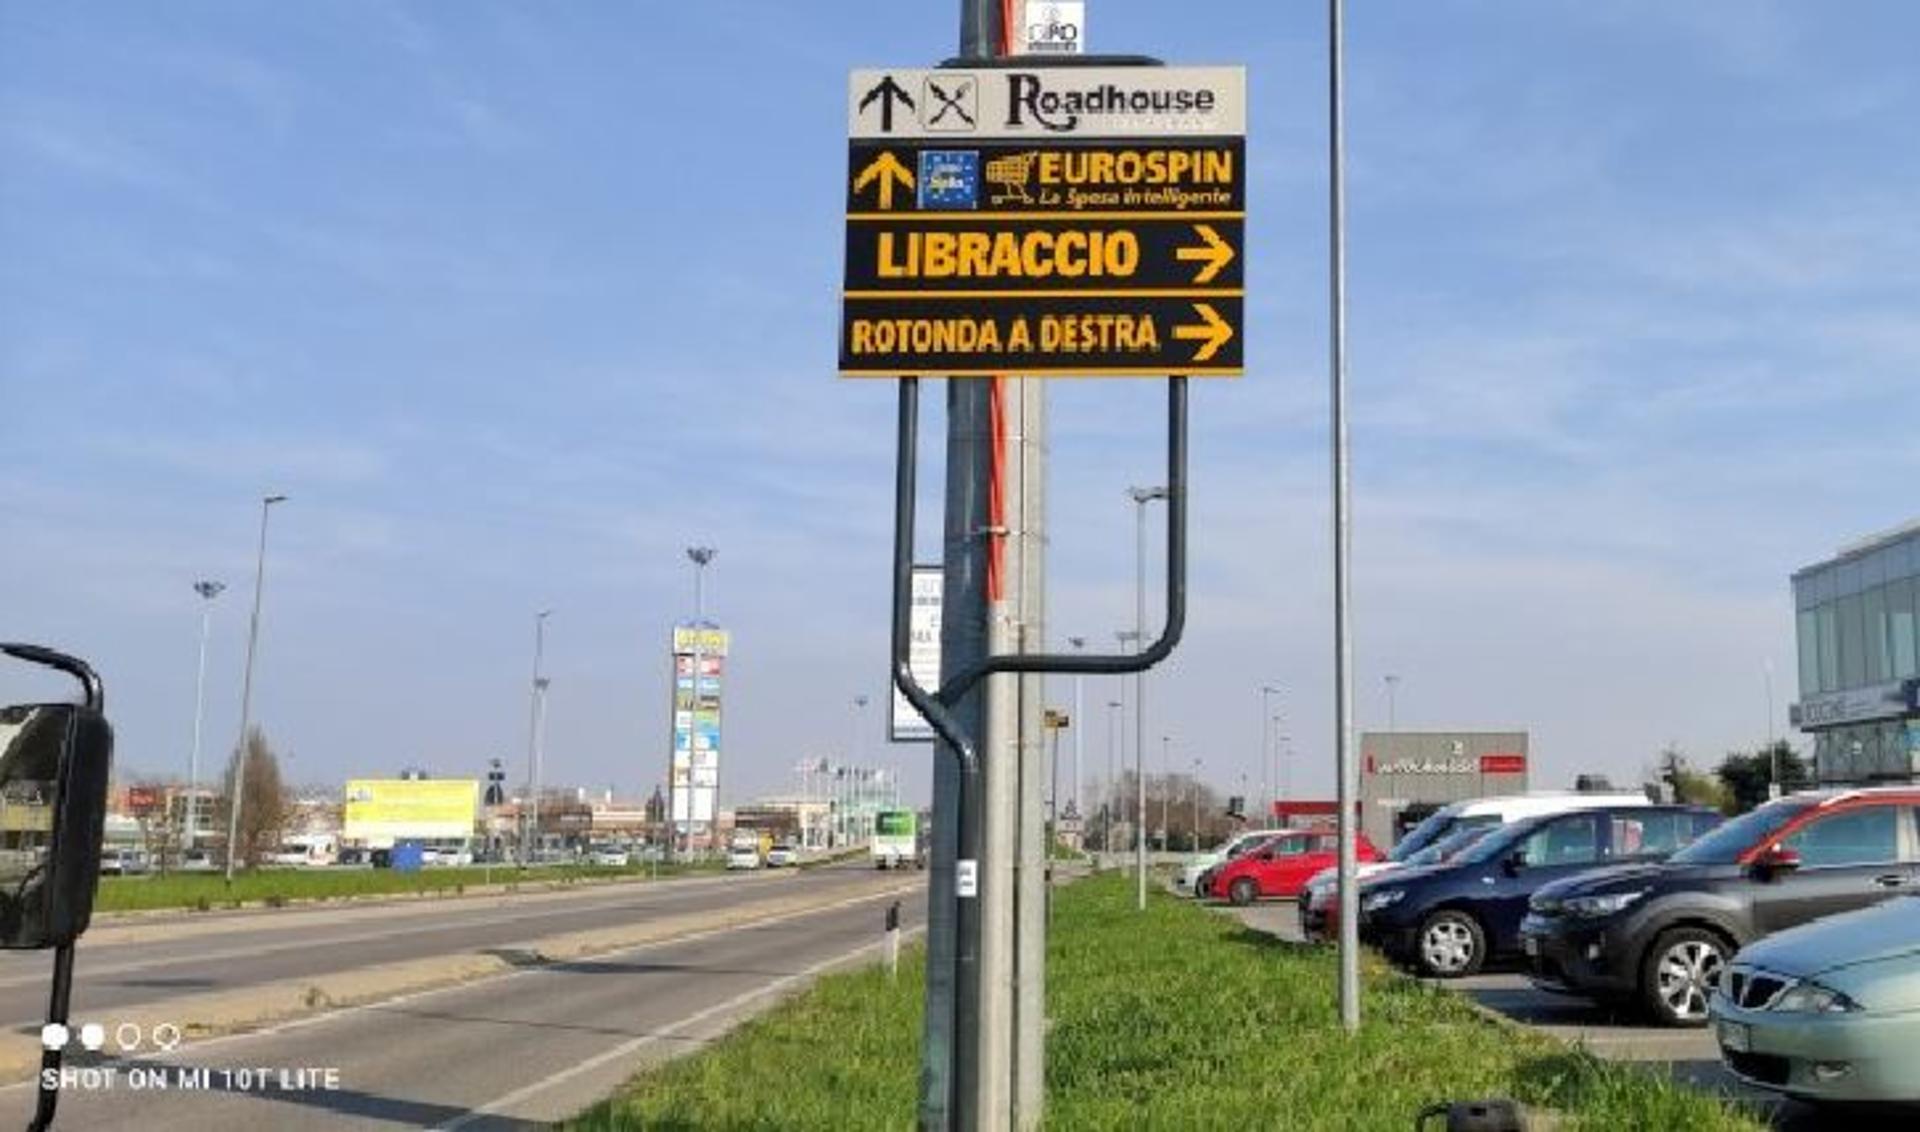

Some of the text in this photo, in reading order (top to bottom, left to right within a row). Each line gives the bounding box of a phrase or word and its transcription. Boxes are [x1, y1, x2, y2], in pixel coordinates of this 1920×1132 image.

[1004, 73, 1215, 131] Roadhouse
[1038, 151, 1232, 184] EUROSPIN
[876, 231, 1140, 279] LIBRACCIO
[851, 314, 1158, 355] ROTONDA A DESTRA
